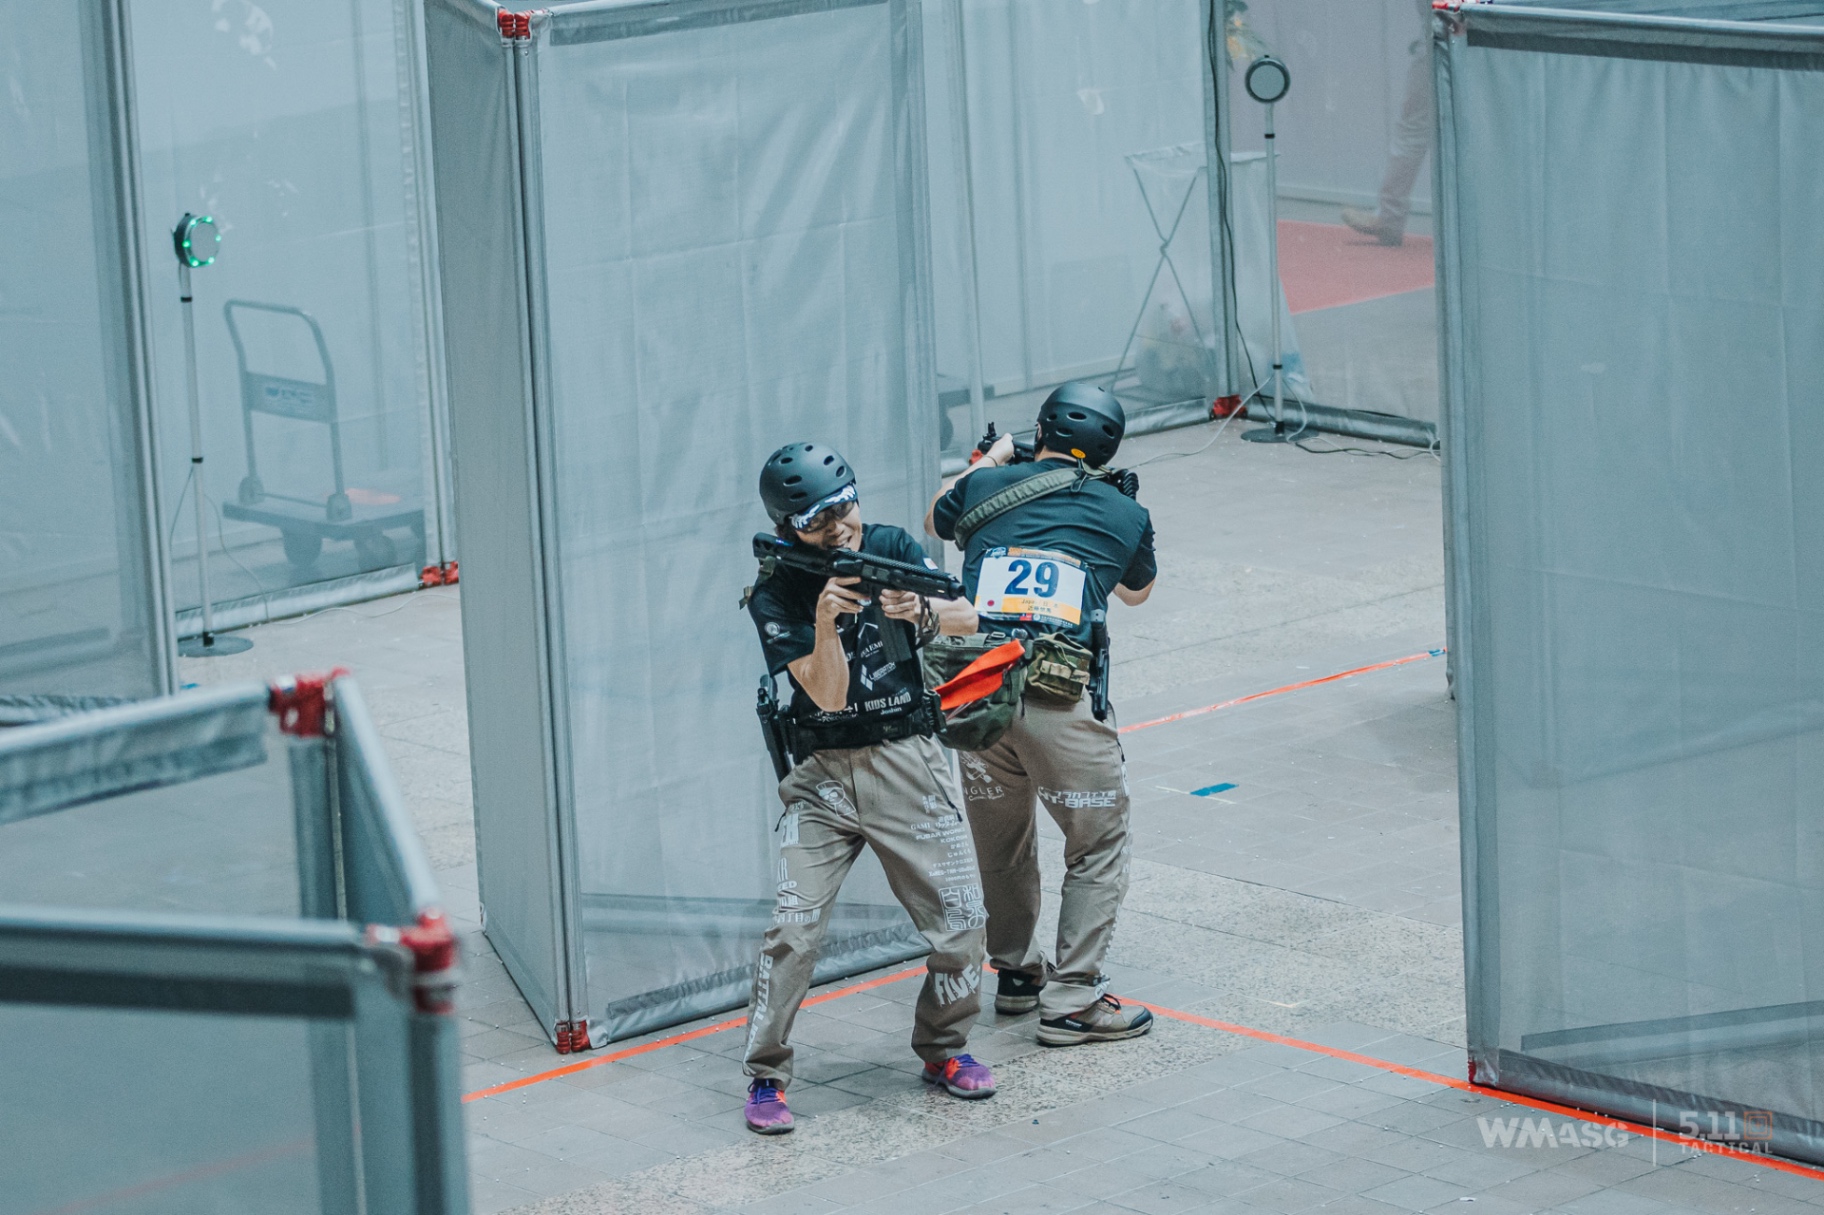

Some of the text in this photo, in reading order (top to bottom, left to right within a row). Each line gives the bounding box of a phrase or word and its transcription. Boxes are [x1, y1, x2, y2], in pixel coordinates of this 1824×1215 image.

[1004, 559, 1060, 598] 29
[864, 697, 886, 712] KIDS
[887, 691, 912, 707] LAND
